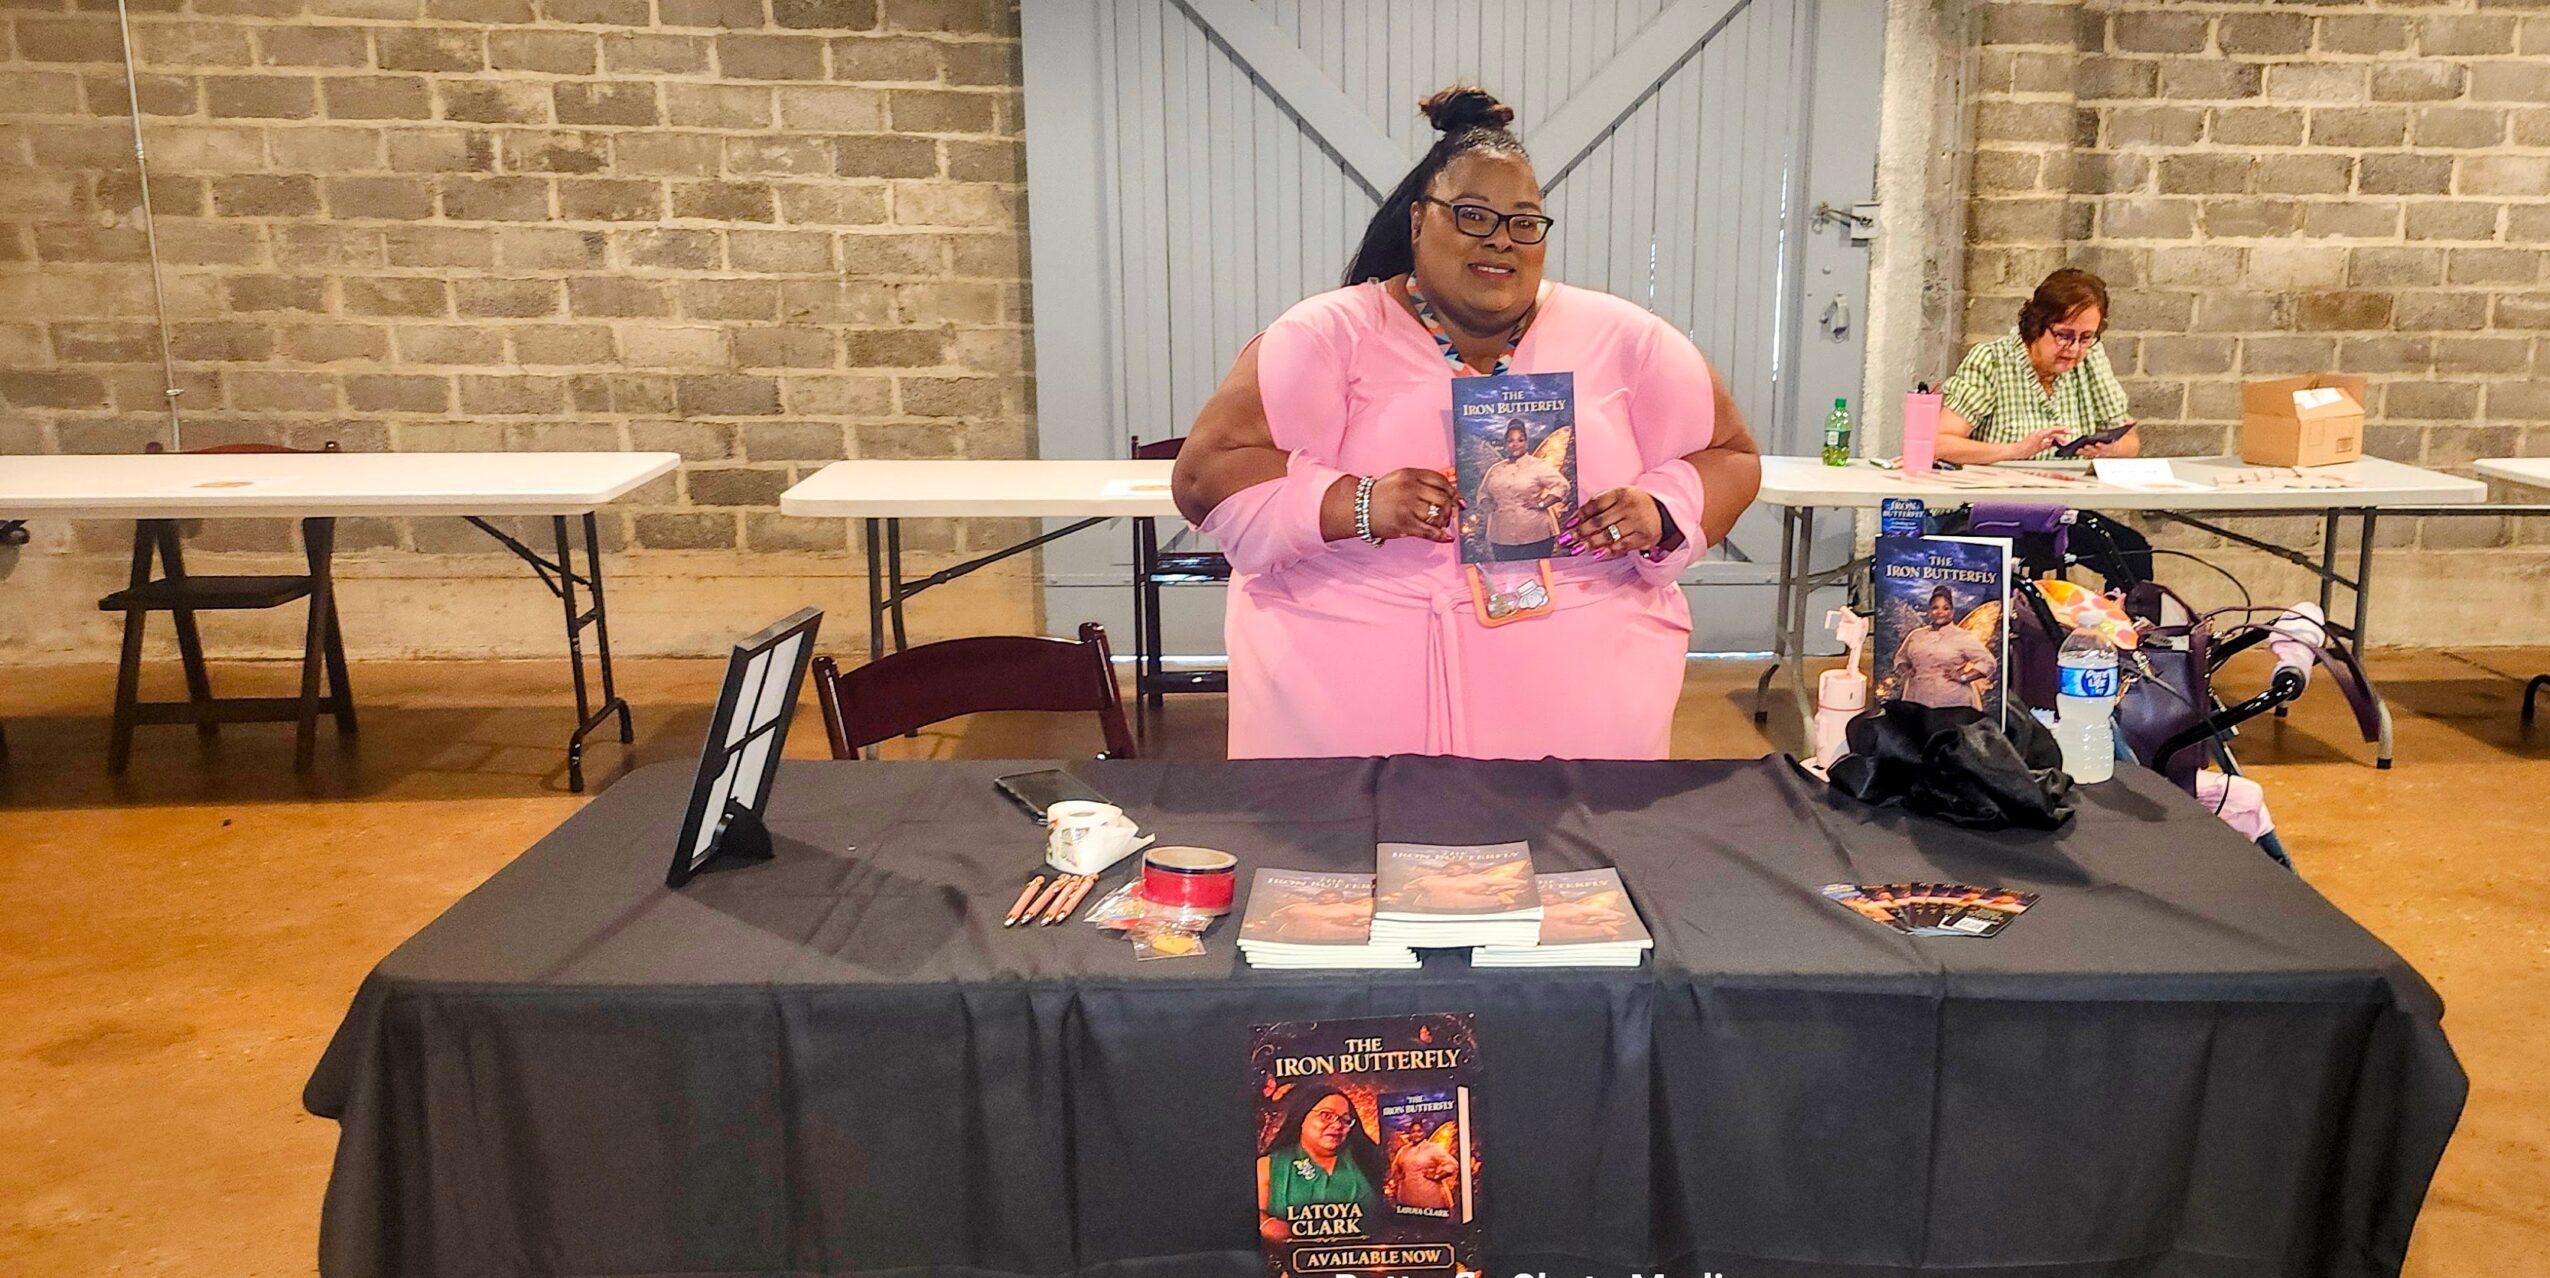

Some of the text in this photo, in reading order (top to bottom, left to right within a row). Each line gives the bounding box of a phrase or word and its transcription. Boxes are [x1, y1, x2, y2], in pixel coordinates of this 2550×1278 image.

[1502, 391, 1526, 401] THE
[1463, 399, 1566, 416] IRON BUTTERFLY
[1928, 555, 1954, 567] THE
[1886, 564, 1998, 584] IRON BUTTERFLY
[1345, 1038, 1383, 1053] THE
[1275, 1049, 1461, 1077] IRON BUTTERFLY
[1287, 1203, 1363, 1221] LATOYA
[1291, 1218, 1361, 1236] CLARK
[1307, 1249, 1442, 1267] AVAILABLE NOW
